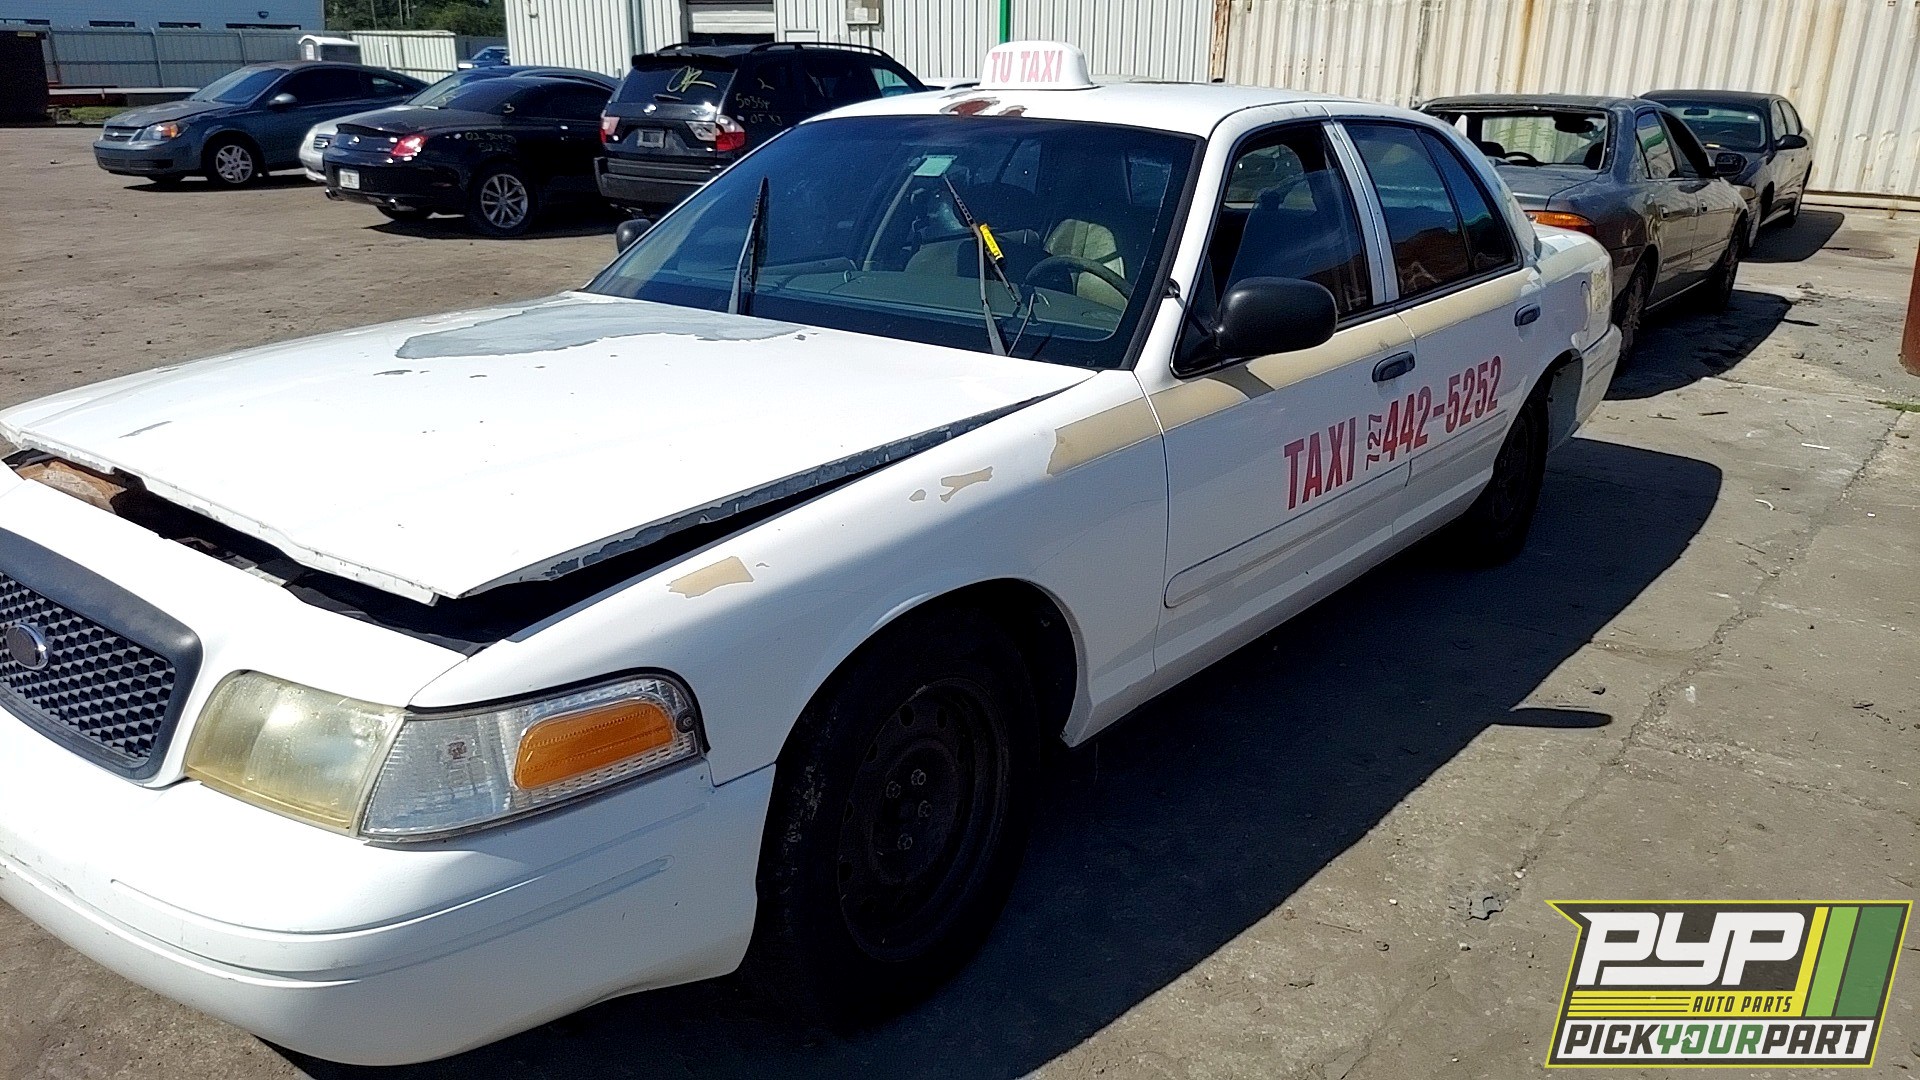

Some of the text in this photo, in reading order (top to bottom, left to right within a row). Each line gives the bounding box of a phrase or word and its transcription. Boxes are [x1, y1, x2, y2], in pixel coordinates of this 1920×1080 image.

[991, 50, 1063, 83] TU TAXI
[503, 102, 515, 114] 3
[1284, 355, 1502, 510] TAXI 727 442-5252
